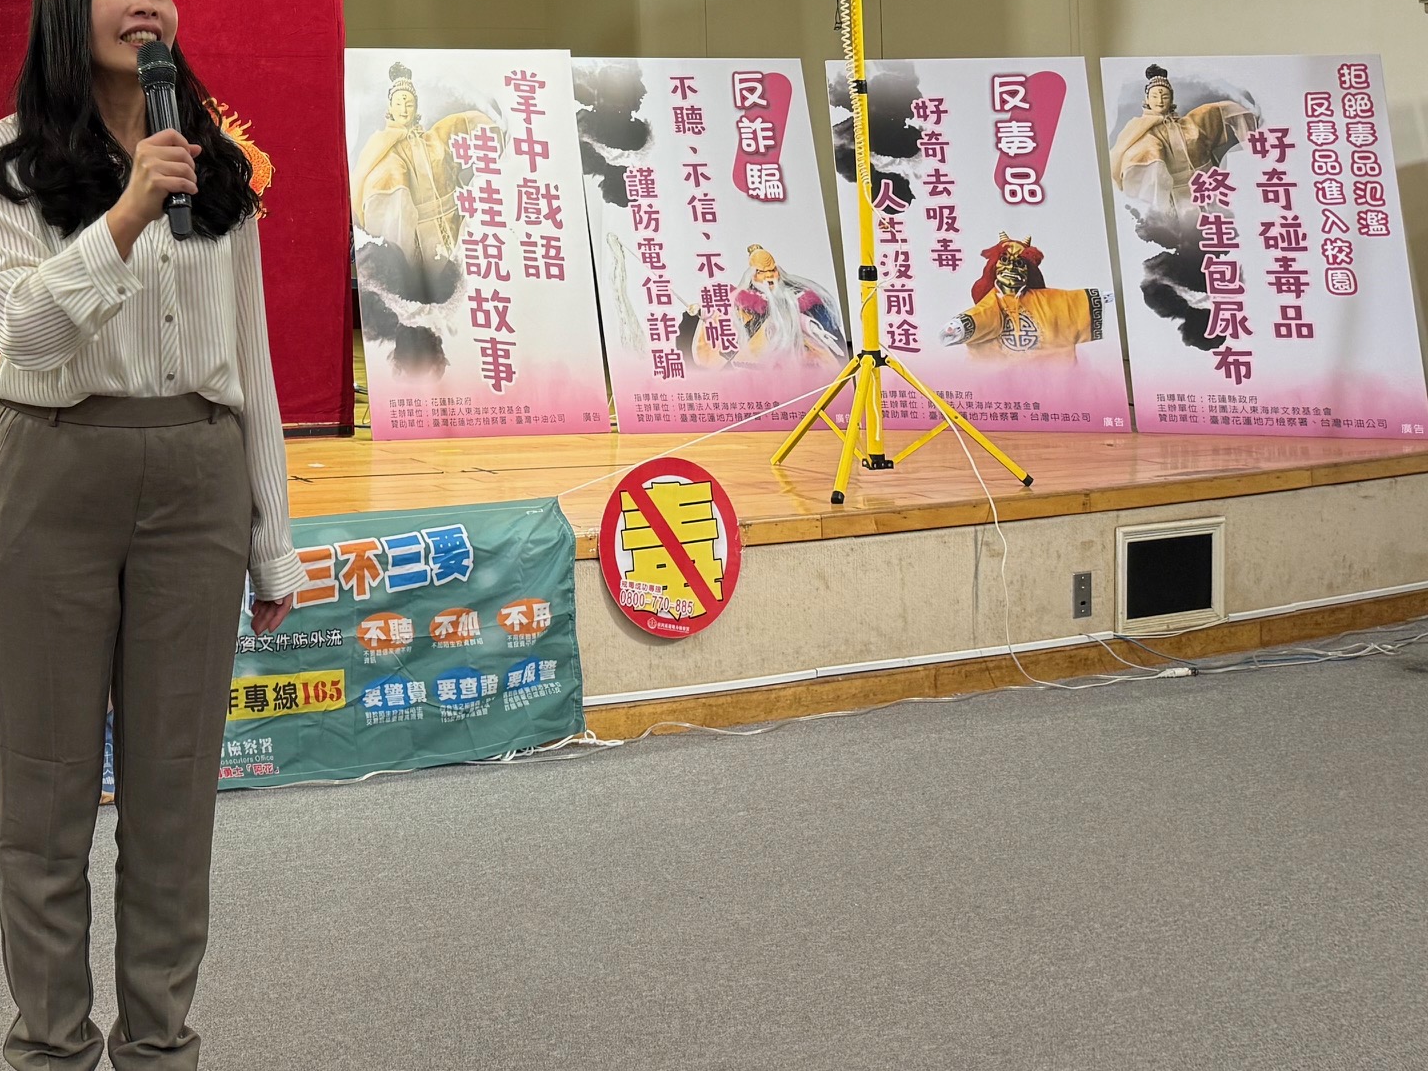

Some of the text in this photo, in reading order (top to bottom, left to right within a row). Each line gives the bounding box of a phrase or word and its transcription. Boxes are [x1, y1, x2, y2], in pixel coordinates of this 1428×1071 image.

[505, 69, 566, 282] 掌中戲語
[732, 71, 787, 202] 反詐騙
[912, 97, 963, 272] 好奇去吸毒
[992, 74, 1044, 204] 反毒品
[1304, 92, 1358, 295] 反毒品進入校園
[1338, 63, 1391, 237] 拒絕毒品氾濫
[452, 127, 517, 392] 娃娃說故事
[625, 168, 685, 379] 謹防電信詐騙
[670, 75, 738, 353] 不聽、不信、不轉帳
[872, 180, 920, 353] 人生沒前途
[1190, 168, 1254, 386] 終生包尿布
[1249, 127, 1315, 339] 好奇碰毒品
[583, 412, 602, 423] 廣告
[1103, 416, 1124, 427] 廣告
[1401, 423, 1424, 435] 廣告
[244, 523, 475, 617] 三不三要
[361, 617, 413, 647] 不聽
[500, 602, 551, 631] 不用
[619, 590, 694, 615] 0800-770-885
[236, 629, 344, 654] 資文件防外流
[221, 737, 273, 758] 檢察署
